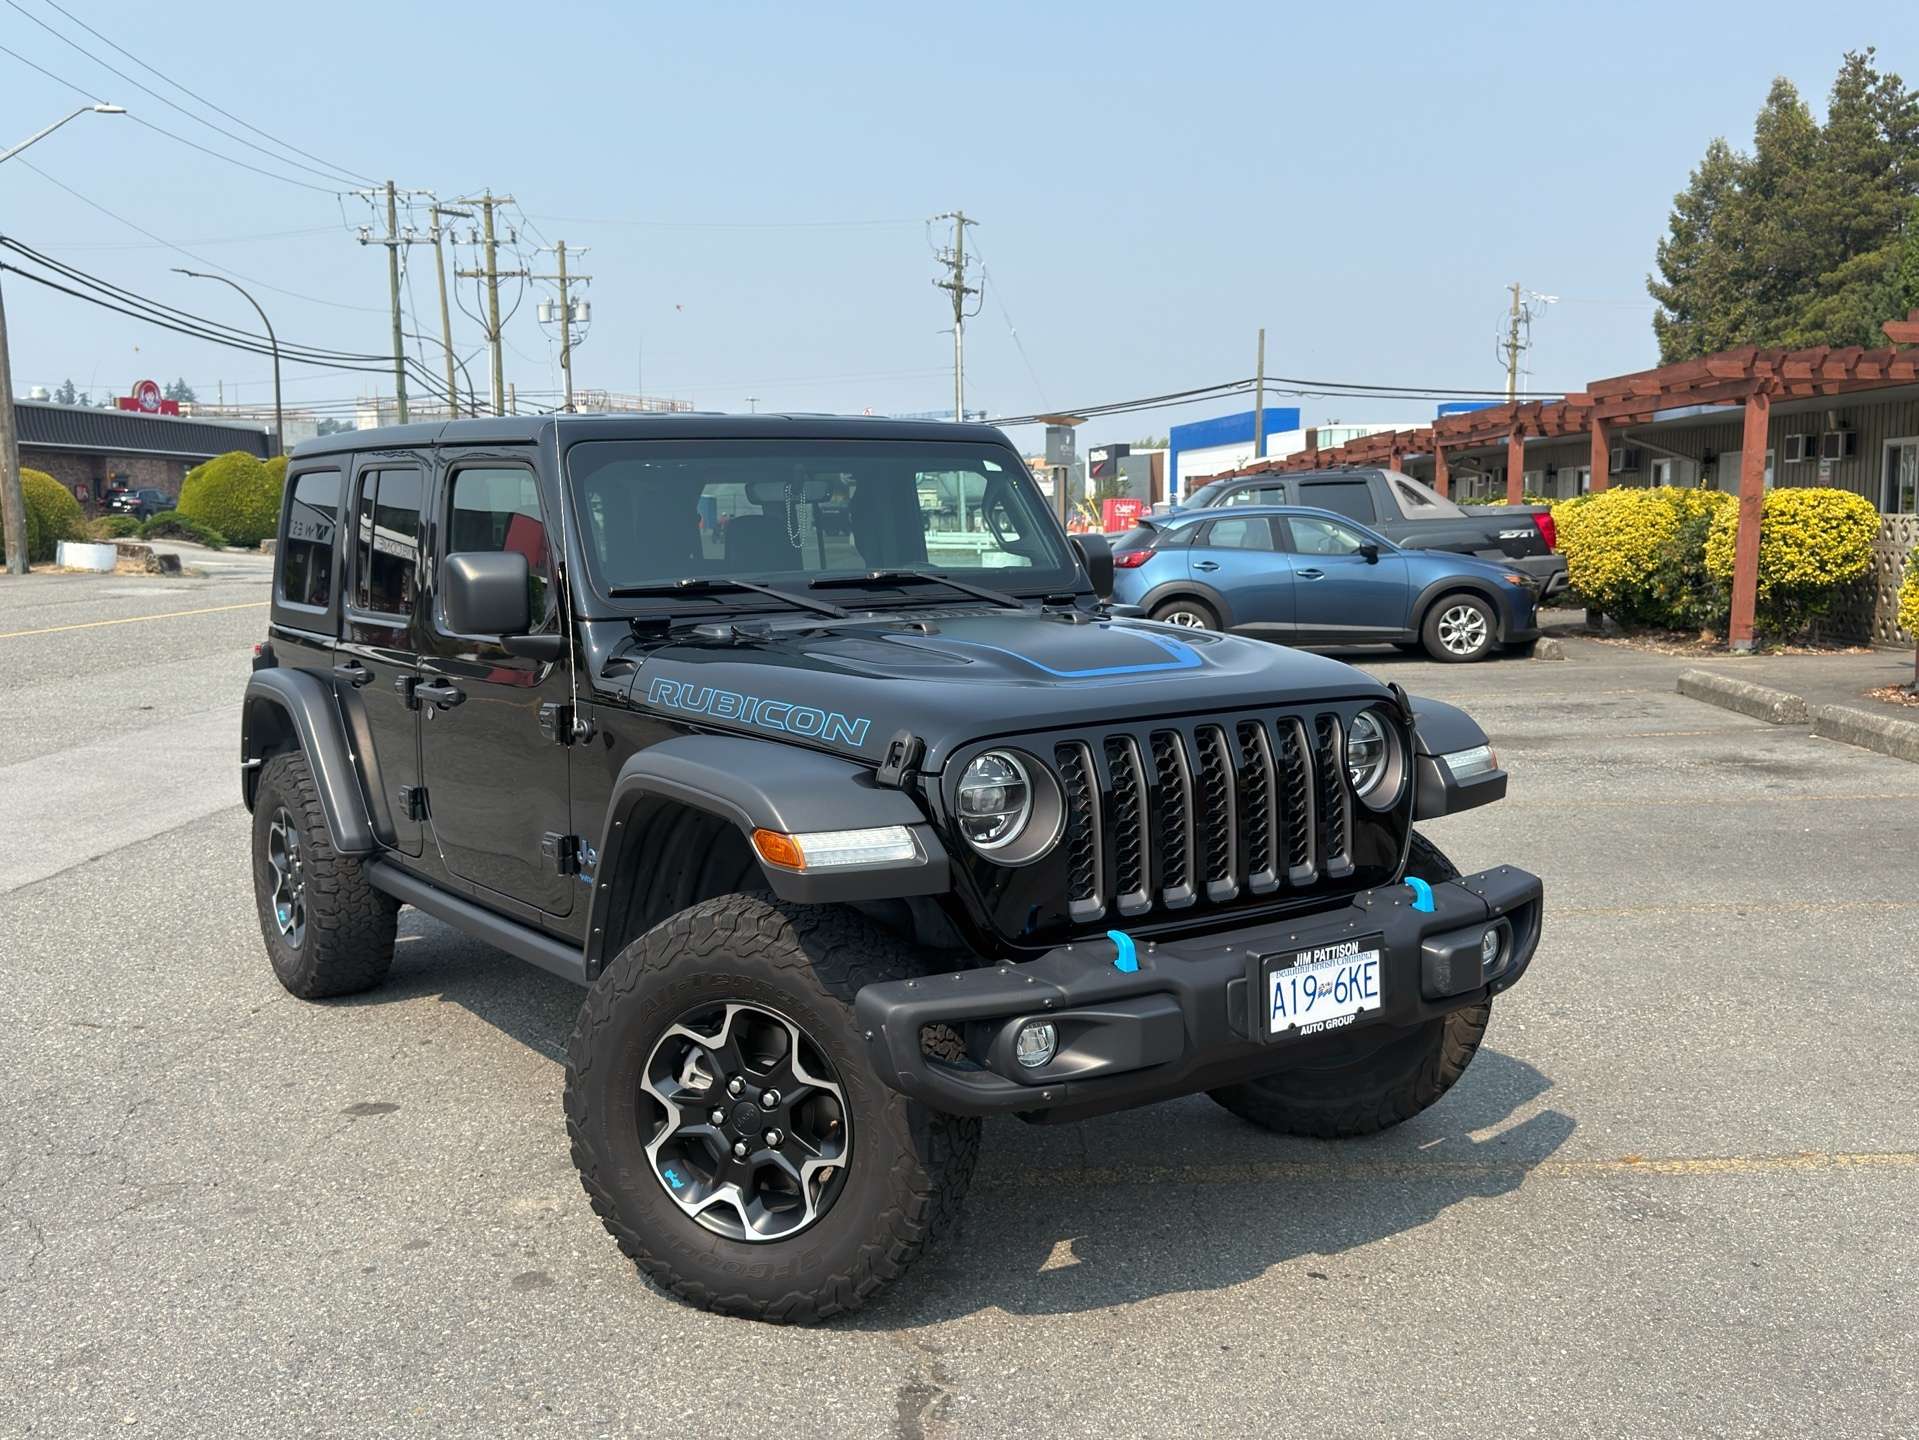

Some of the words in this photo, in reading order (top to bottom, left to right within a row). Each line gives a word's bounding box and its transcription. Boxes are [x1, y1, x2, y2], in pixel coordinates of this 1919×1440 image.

[647, 677, 872, 747] RUBICON
[576, 839, 599, 865] Je
[1293, 951, 1311, 967] JIM
[1313, 941, 1359, 963] PATTISON
[1300, 1022, 1324, 1036] AUTO
[1325, 1014, 1356, 1030] GROUP
